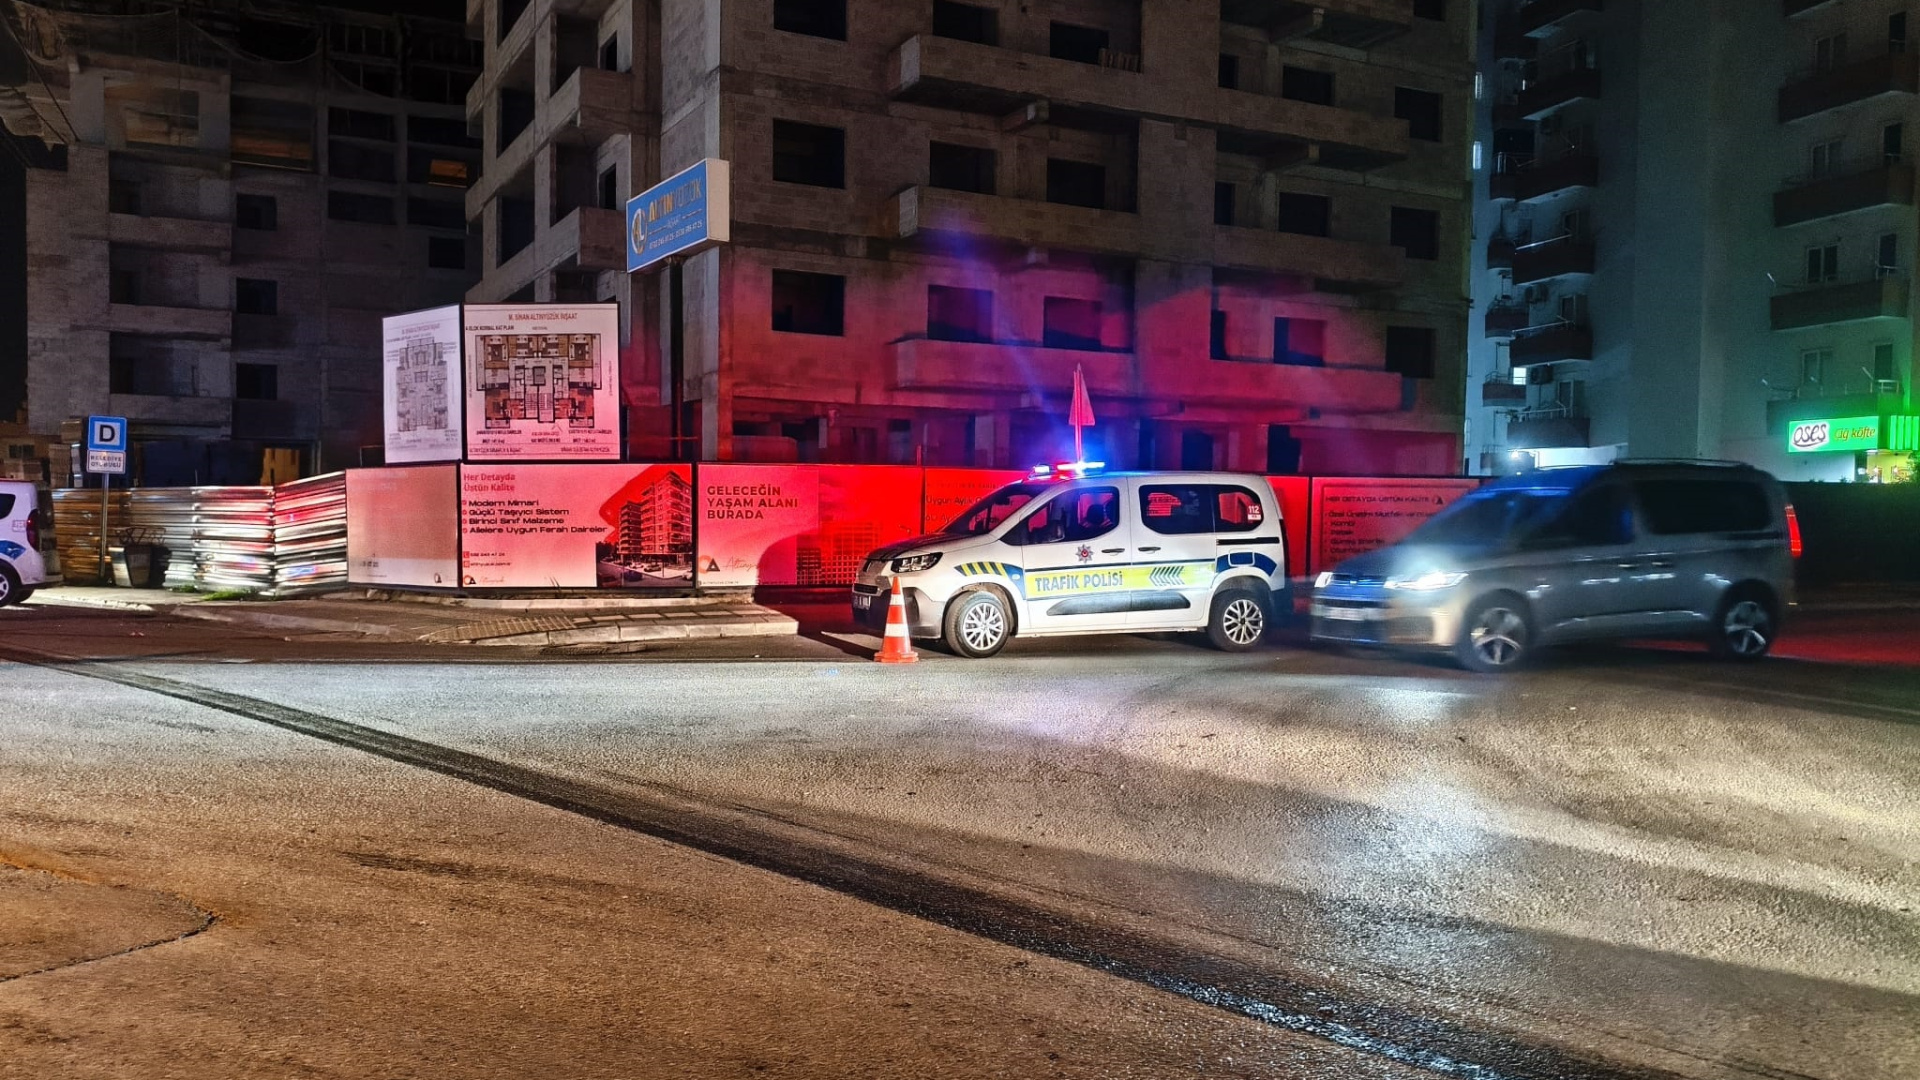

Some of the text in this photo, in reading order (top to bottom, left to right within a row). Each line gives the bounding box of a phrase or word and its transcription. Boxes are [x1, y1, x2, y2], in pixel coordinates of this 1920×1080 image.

[99, 425, 115, 441] D
[481, 473, 516, 482] Detayda
[464, 483, 515, 491] Üstün Kalite
[707, 484, 781, 496] GELECEĞİN
[707, 498, 798, 510] YAŞAM ALANI
[469, 508, 495, 517] Güçlü
[497, 508, 533, 517] Taşıyıcı
[1248, 505, 1260, 513] 112
[707, 509, 764, 519] BURADA
[506, 527, 537, 535] Uygun
[1035, 571, 1123, 592] TRAFİK POLİSİ
